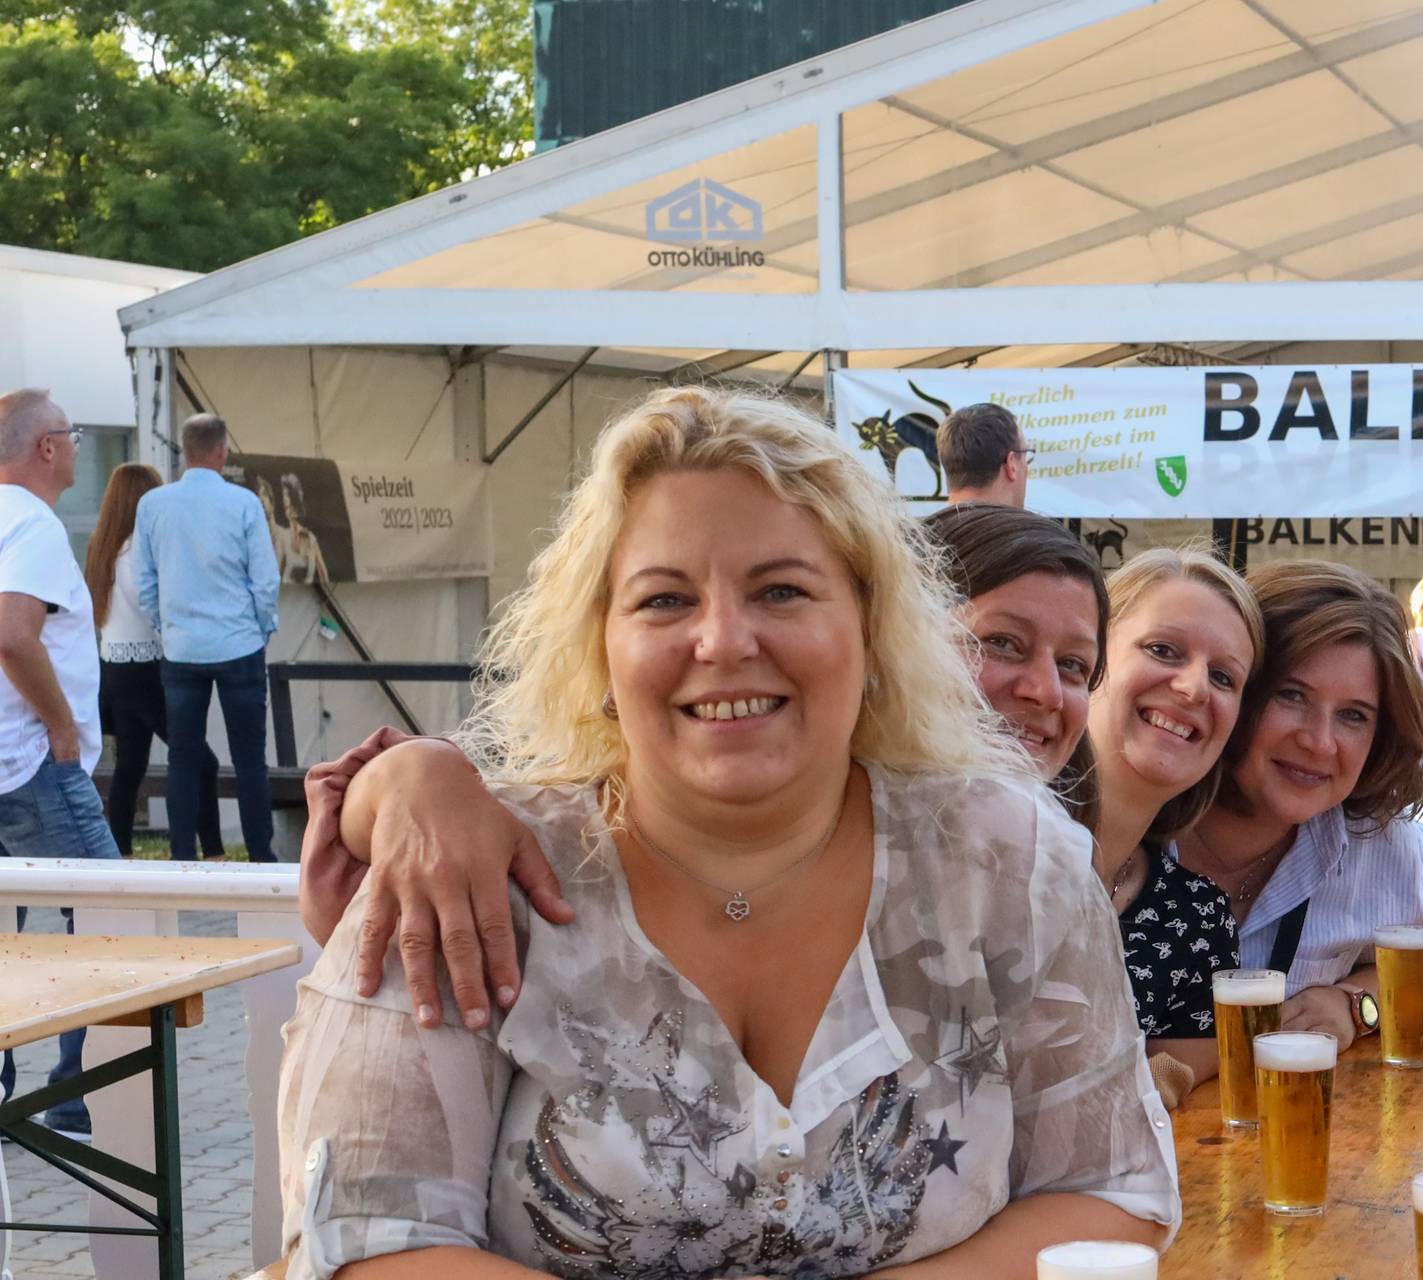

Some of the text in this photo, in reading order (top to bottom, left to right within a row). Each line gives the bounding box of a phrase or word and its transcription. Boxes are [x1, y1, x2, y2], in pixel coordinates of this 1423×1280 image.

[648, 250, 690, 267] OTTO
[990, 384, 1075, 406] Herzlich
[1017, 403, 1168, 429] lkommen zum
[1029, 428, 1156, 453] tzenfest im
[1027, 451, 1143, 480] erwehrzelt!
[352, 475, 415, 502] Spielzeit
